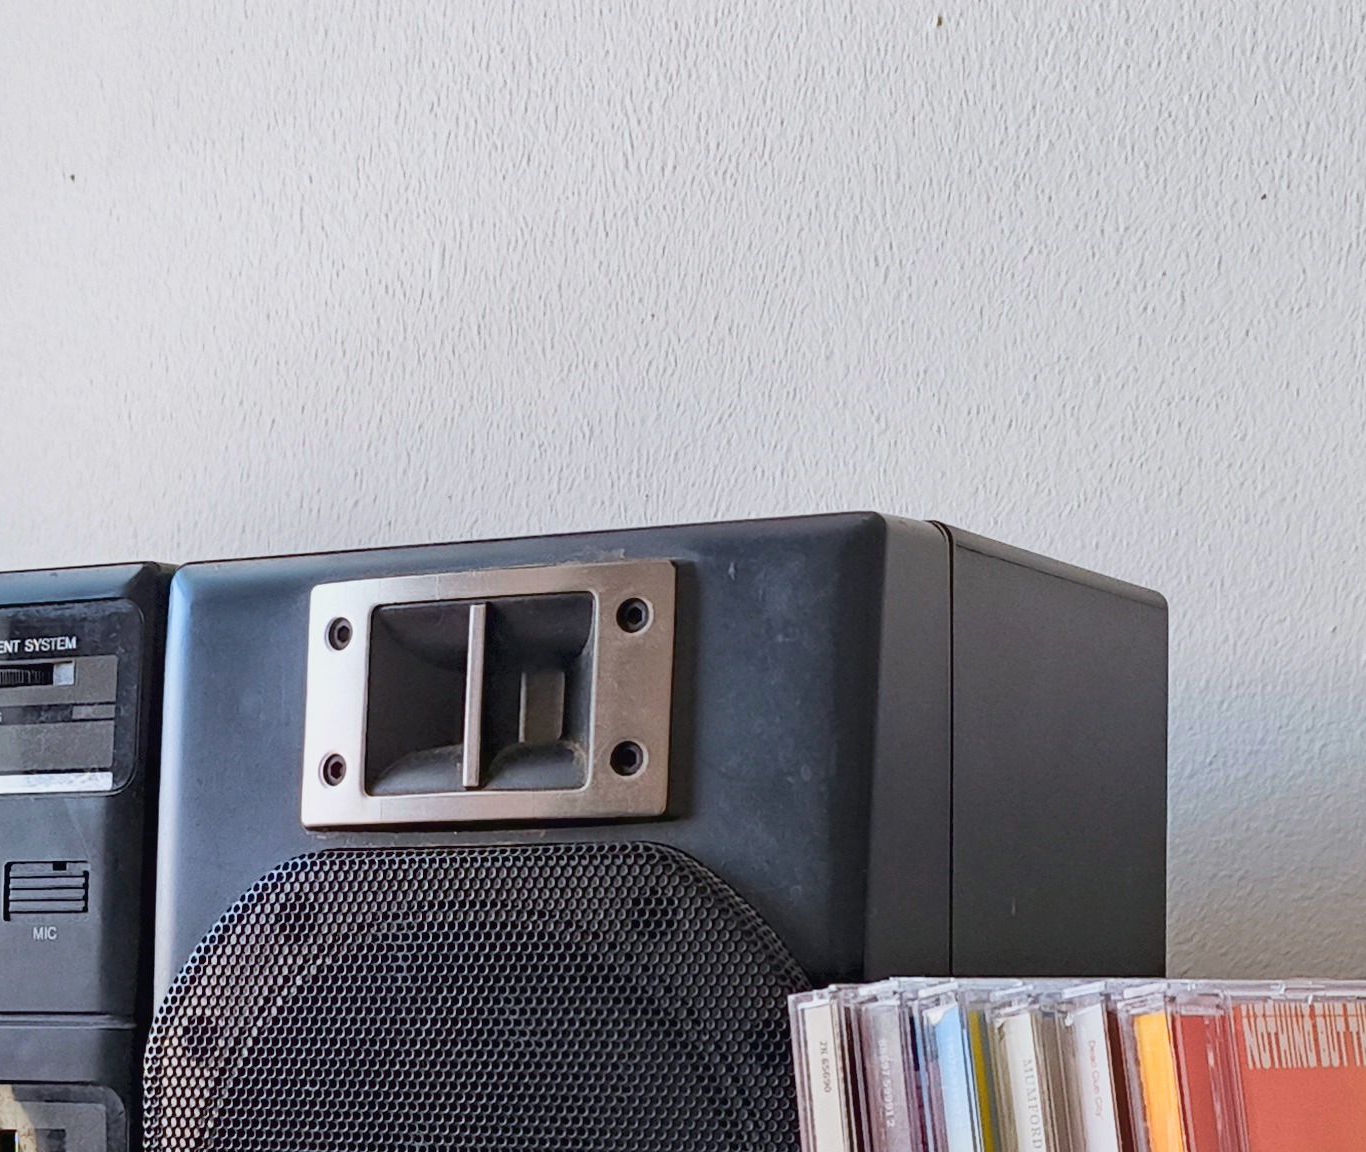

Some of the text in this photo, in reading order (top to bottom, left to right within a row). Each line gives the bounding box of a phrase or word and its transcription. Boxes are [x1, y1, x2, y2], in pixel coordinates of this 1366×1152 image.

[24, 635, 77, 653] SYSTEM
[33, 926, 57, 940] MIC
[1242, 1016, 1318, 1071] NOTHING
[1317, 1016, 1349, 1069] BUT
[1023, 1058, 1043, 1151] MUMFORD
